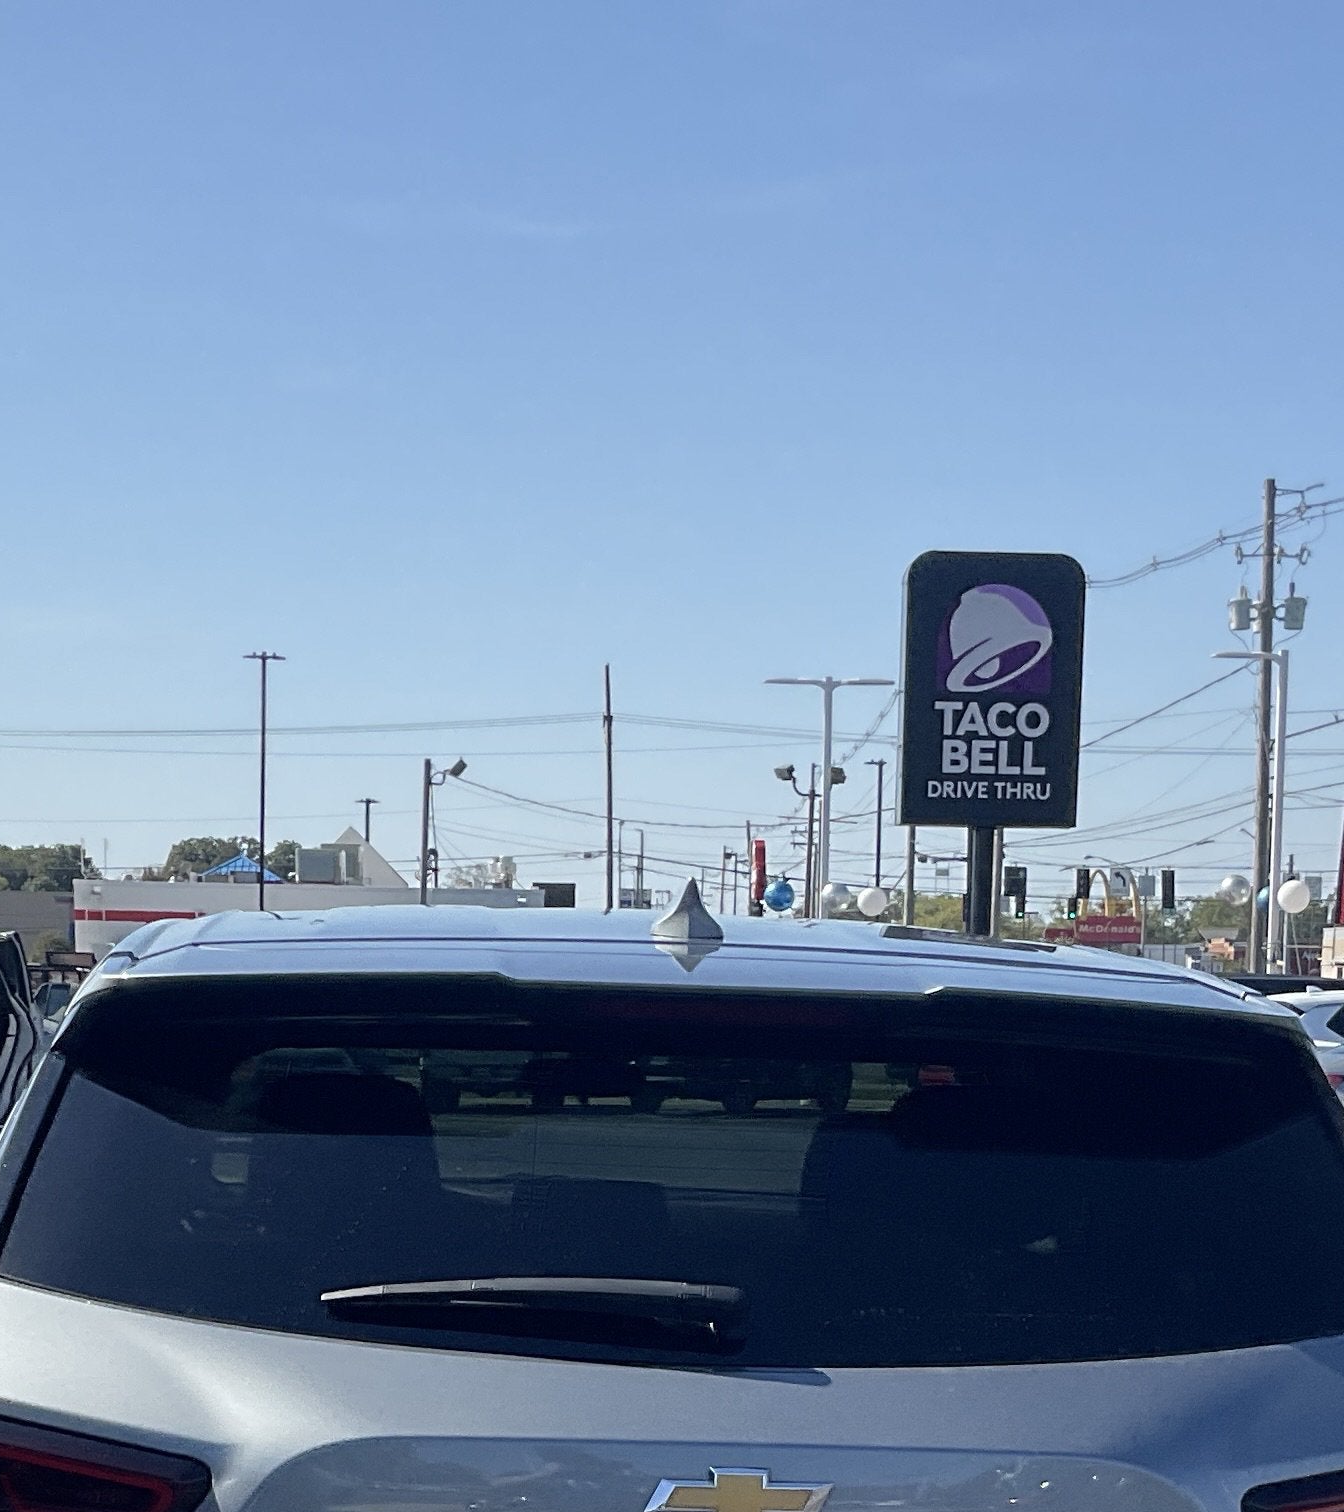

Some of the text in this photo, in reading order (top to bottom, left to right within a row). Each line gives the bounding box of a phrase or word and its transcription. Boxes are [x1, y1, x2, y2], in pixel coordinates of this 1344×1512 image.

[934, 701, 1050, 738] TACO
[941, 739, 1046, 775] BELL
[927, 780, 1051, 800] DRIVE THRU
